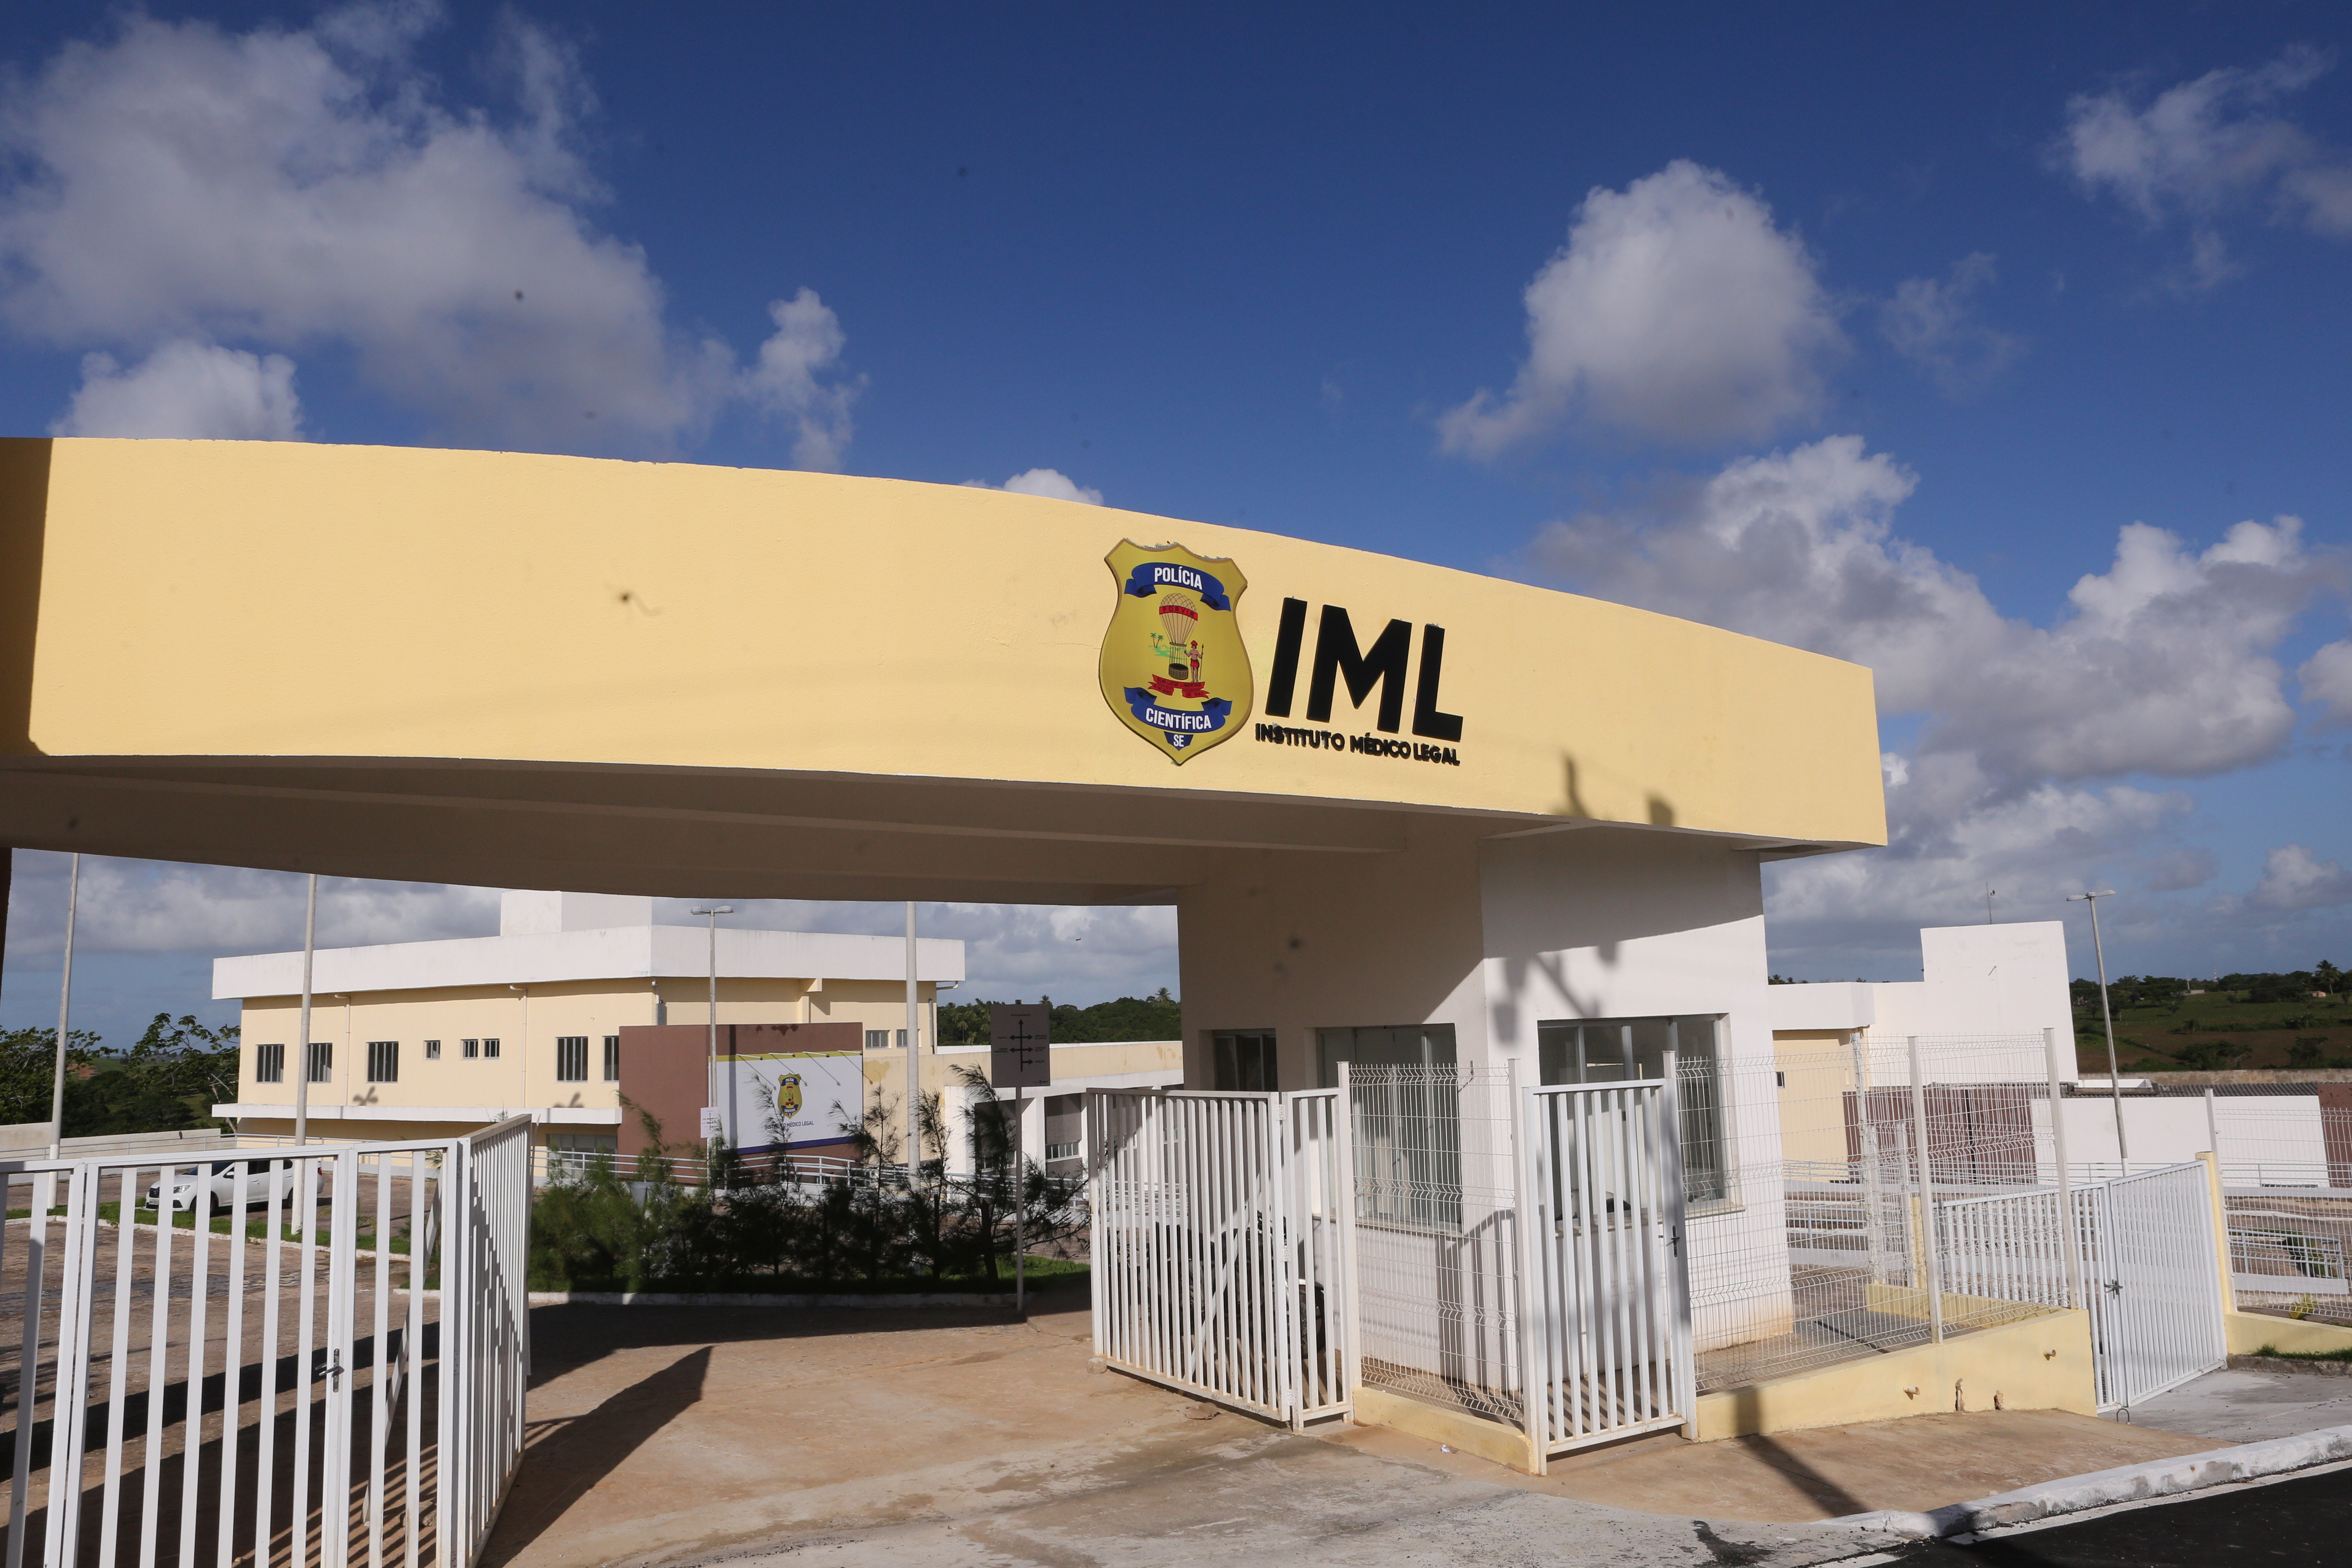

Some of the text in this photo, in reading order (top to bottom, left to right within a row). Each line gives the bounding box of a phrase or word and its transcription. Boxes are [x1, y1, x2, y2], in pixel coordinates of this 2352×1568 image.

[1154, 566, 1203, 590] POLÍCIA
[1163, 606, 1194, 616] PORVIR
[1265, 597, 1463, 742] IML
[1146, 708, 1212, 730] CIENTÍFICA
[1173, 734, 1184, 747] SE
[1256, 723, 1460, 766] INSTITUTO MÉDICO LEGAL
